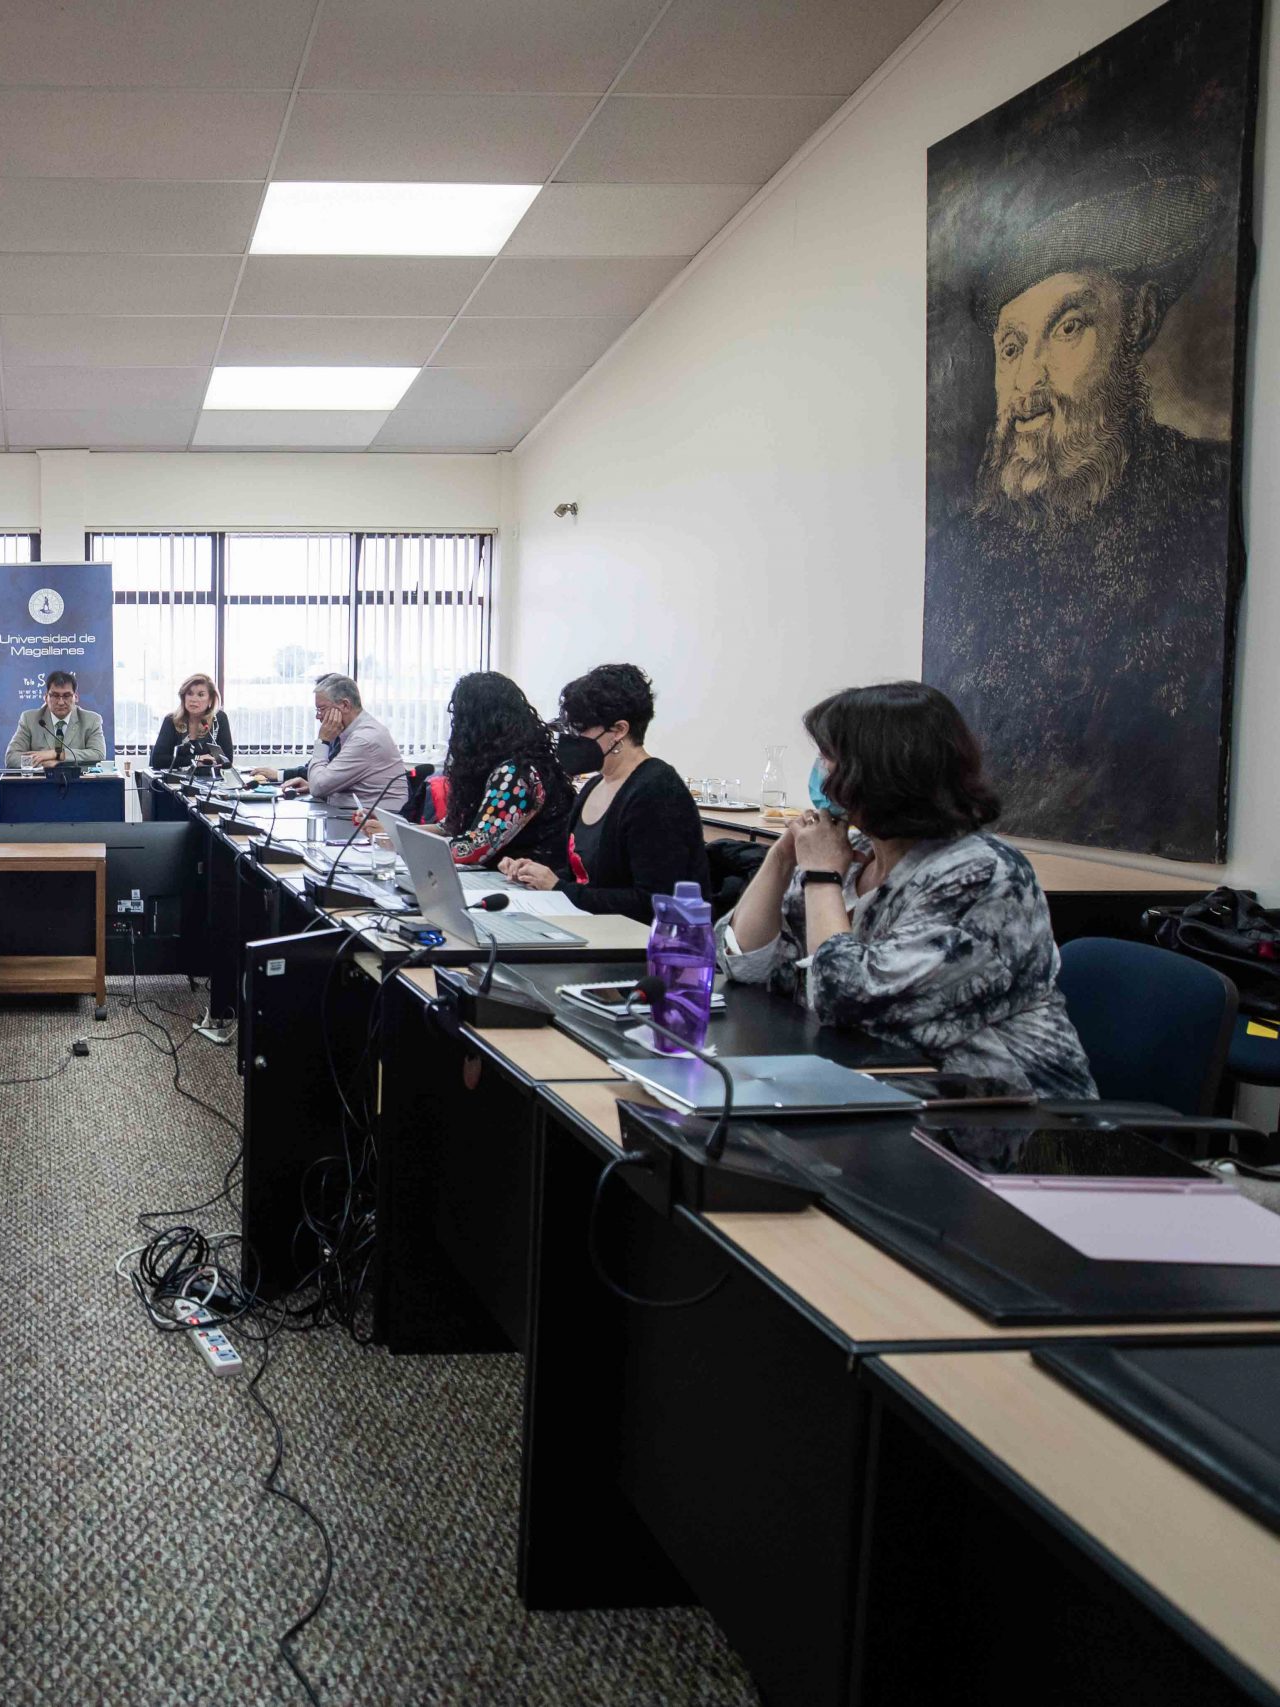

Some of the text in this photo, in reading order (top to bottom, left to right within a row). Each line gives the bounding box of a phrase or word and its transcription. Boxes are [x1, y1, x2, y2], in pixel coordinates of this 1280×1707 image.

[0, 633, 96, 644] Universidad de
[10, 646, 85, 658] Magallanes
